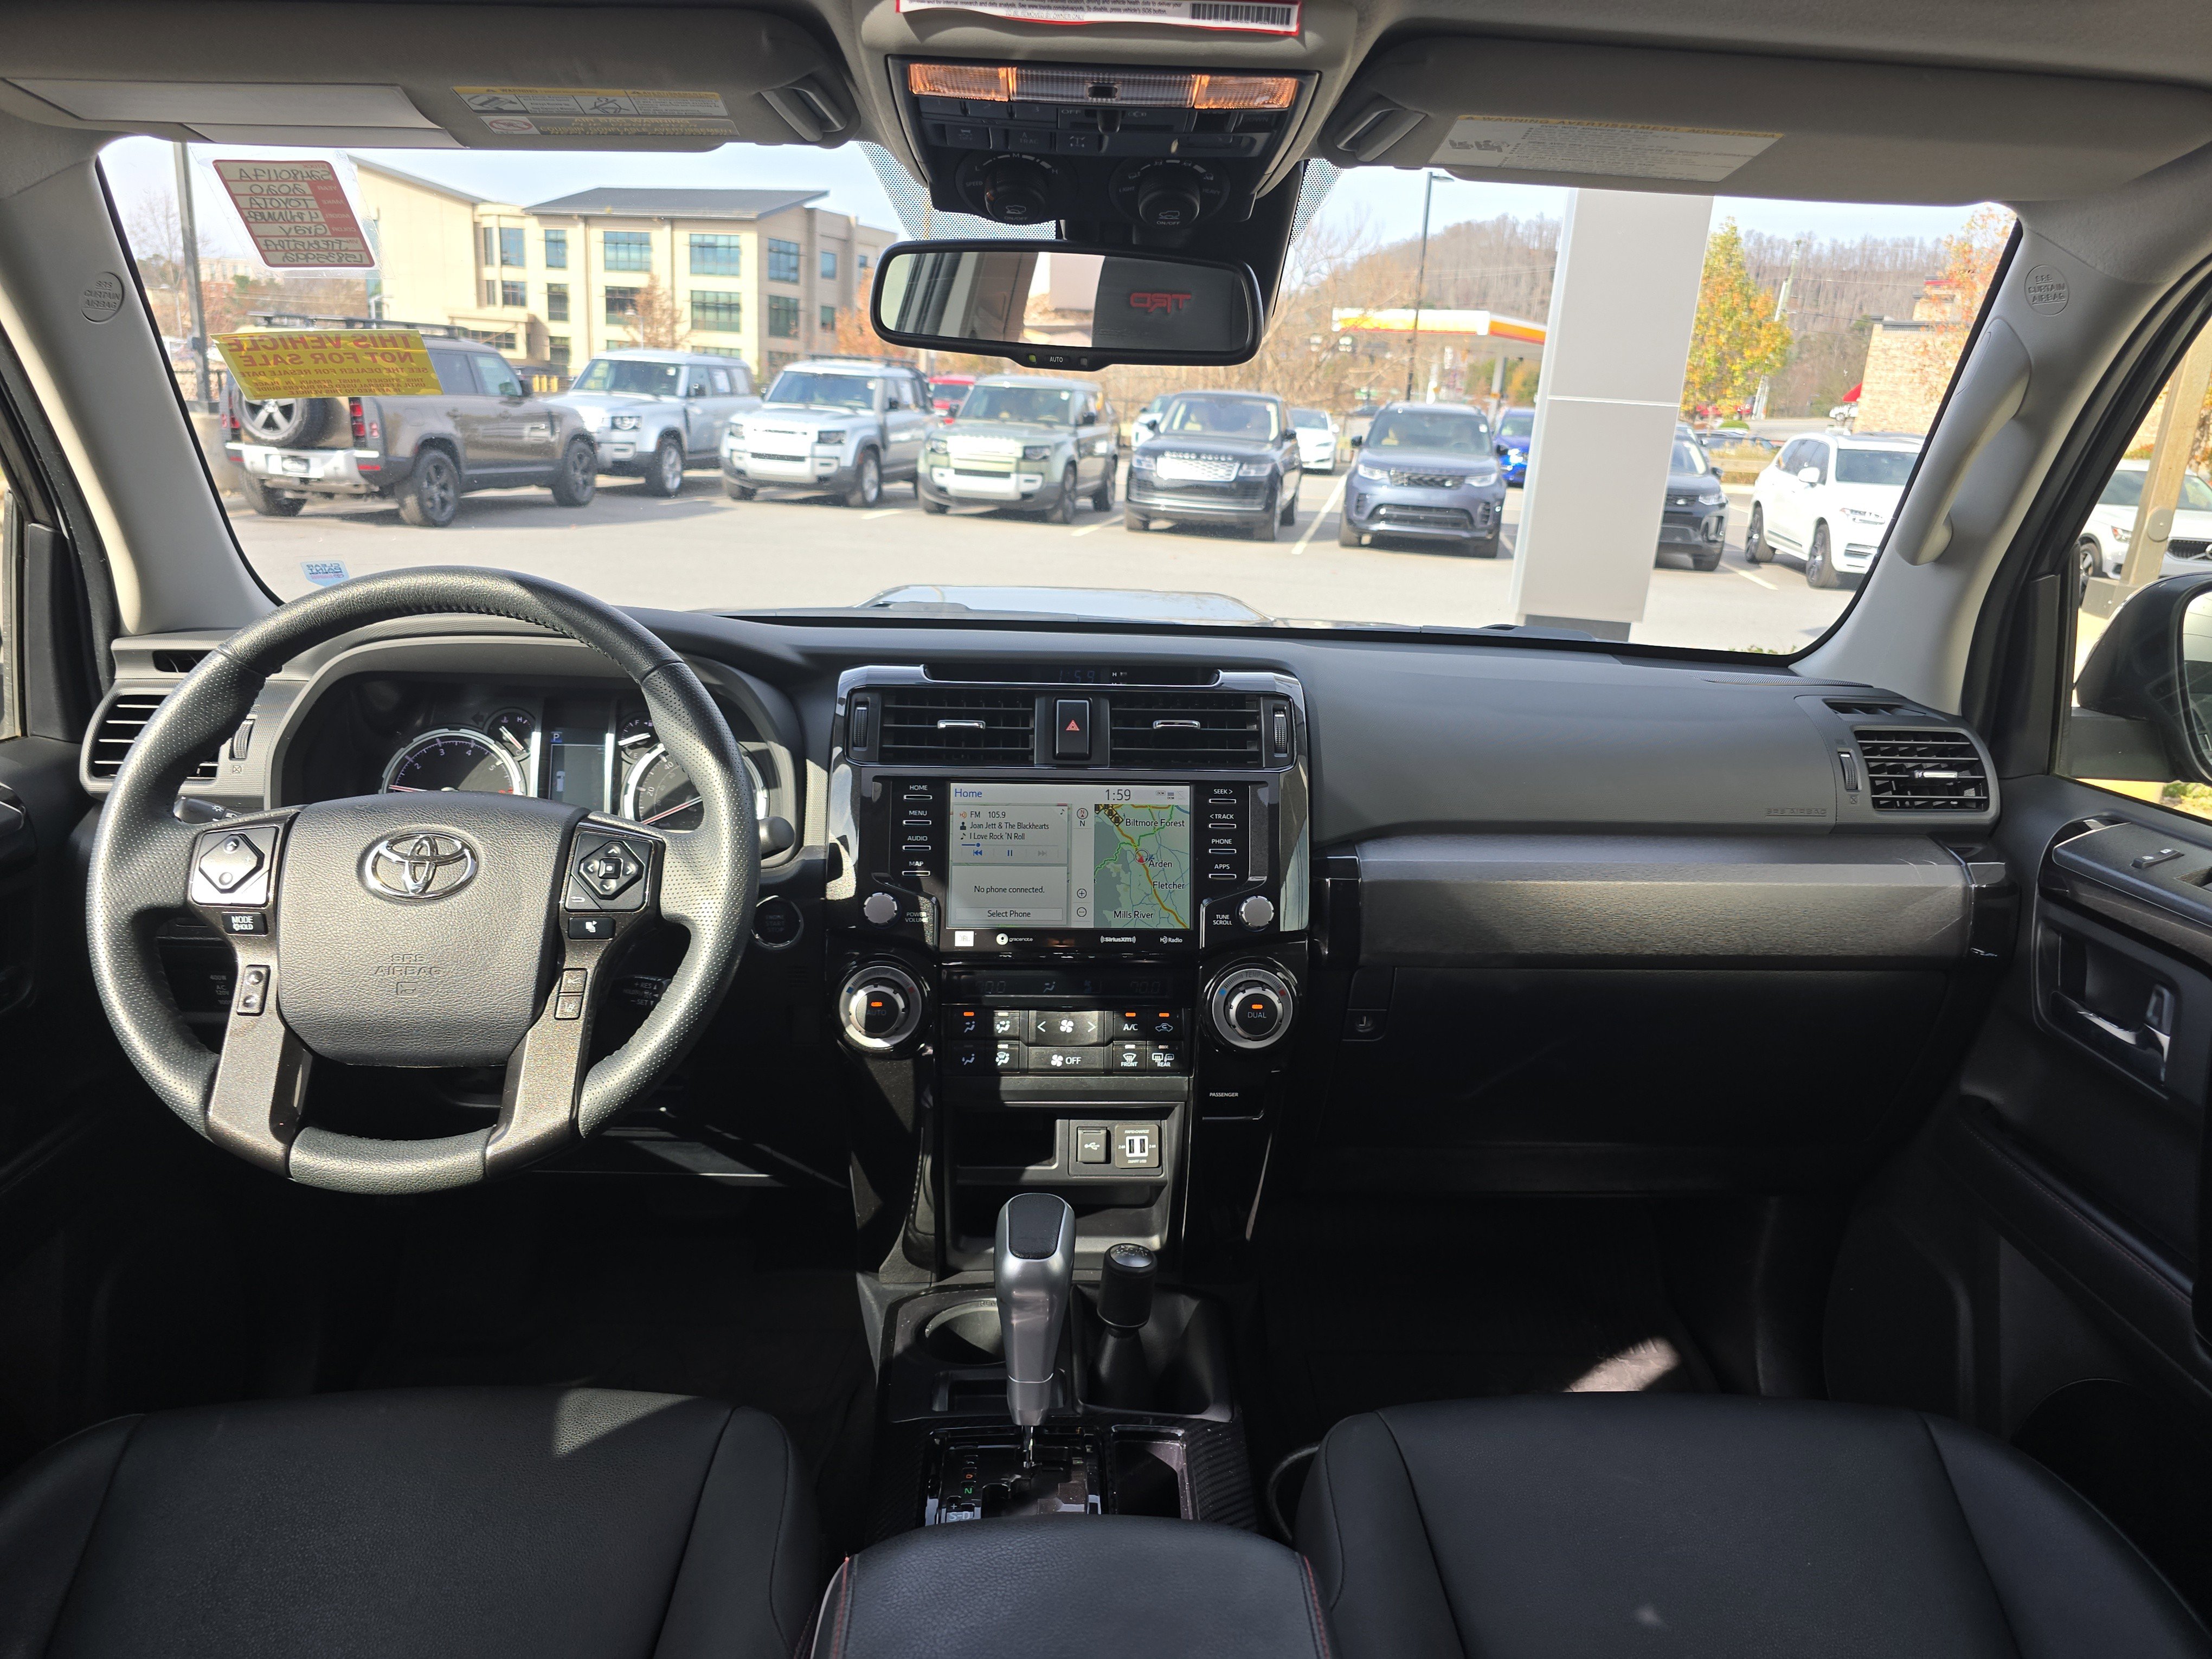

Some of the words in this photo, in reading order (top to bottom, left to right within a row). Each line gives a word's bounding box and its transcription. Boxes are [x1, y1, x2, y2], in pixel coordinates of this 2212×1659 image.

[553, 733, 560, 741] P
[439, 749, 445, 757] 3
[664, 761, 674, 770] 40
[647, 787, 654, 796] 20
[954, 788, 983, 798] Home
[1105, 789, 1131, 801] 1:59
[1017, 822, 1050, 830] Blackhearts
[1125, 819, 1159, 827] Biltmore
[1160, 819, 1186, 827] Forest
[1148, 860, 1173, 868] Arden
[1153, 881, 1186, 890] Fletcher
[986, 885, 1007, 895] phone
[1008, 885, 1045, 893] connected.
[1113, 910, 1132, 919] Mills
[1133, 910, 1154, 919] River
[231, 916, 254, 924] MODE
[391, 953, 427, 964] SRS
[374, 966, 443, 976] AIRBAG
[1248, 1011, 1267, 1019] DUAL
[1123, 1023, 1138, 1031] A/C
[1065, 1057, 1082, 1065] OFF
